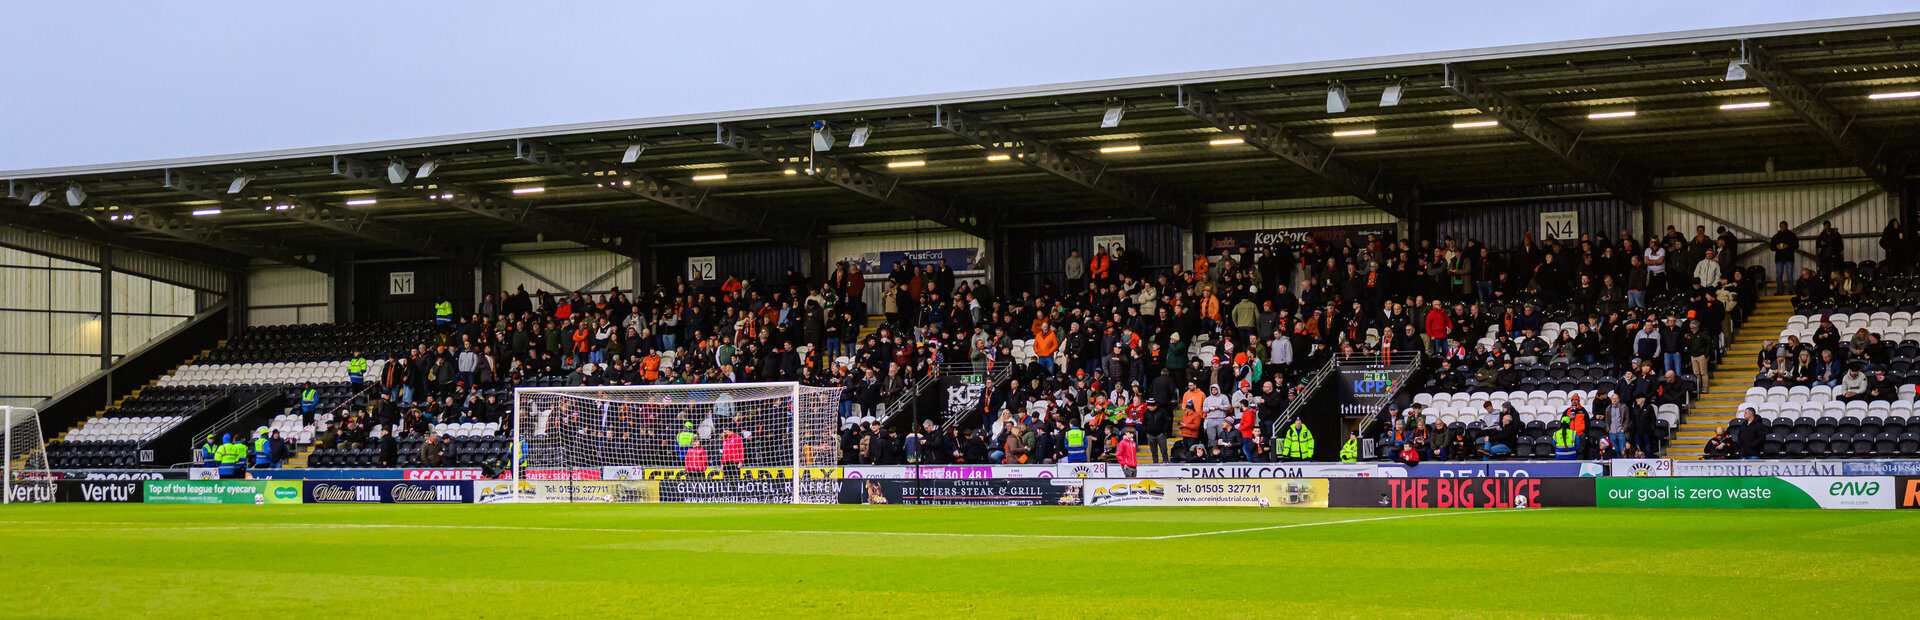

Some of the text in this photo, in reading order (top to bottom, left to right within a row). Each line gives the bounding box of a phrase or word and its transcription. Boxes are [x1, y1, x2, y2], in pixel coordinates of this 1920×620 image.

[1545, 220, 1573, 240] N4
[904, 250, 943, 261] TrustFord
[692, 262, 713, 279] N2
[394, 278, 411, 293] N1
[1354, 380, 1386, 393] KPP
[632, 467, 640, 476] 27
[1094, 464, 1104, 473] 28
[1656, 460, 1670, 470] 29
[1758, 464, 1835, 476] GRAHAM
[8, 484, 50, 502] Vertu
[80, 484, 128, 500] Vertu
[149, 484, 256, 495] Top of the league for eyecare
[312, 484, 380, 502] William HILL
[391, 484, 436, 502] William
[436, 485, 462, 500] HILL
[583, 486, 608, 494] 327711
[678, 482, 843, 494] GLYNHILL HOTEL, RNFREW
[961, 488, 994, 496] STEAK
[998, 486, 1007, 496] &
[1090, 480, 1164, 503] ACRE
[1176, 484, 1260, 493] Tel: 01505 327711
[1388, 479, 1541, 508] THE BIG SLICE
[1608, 486, 1772, 501] our goal is zero waste
[1829, 482, 1880, 496] enva
